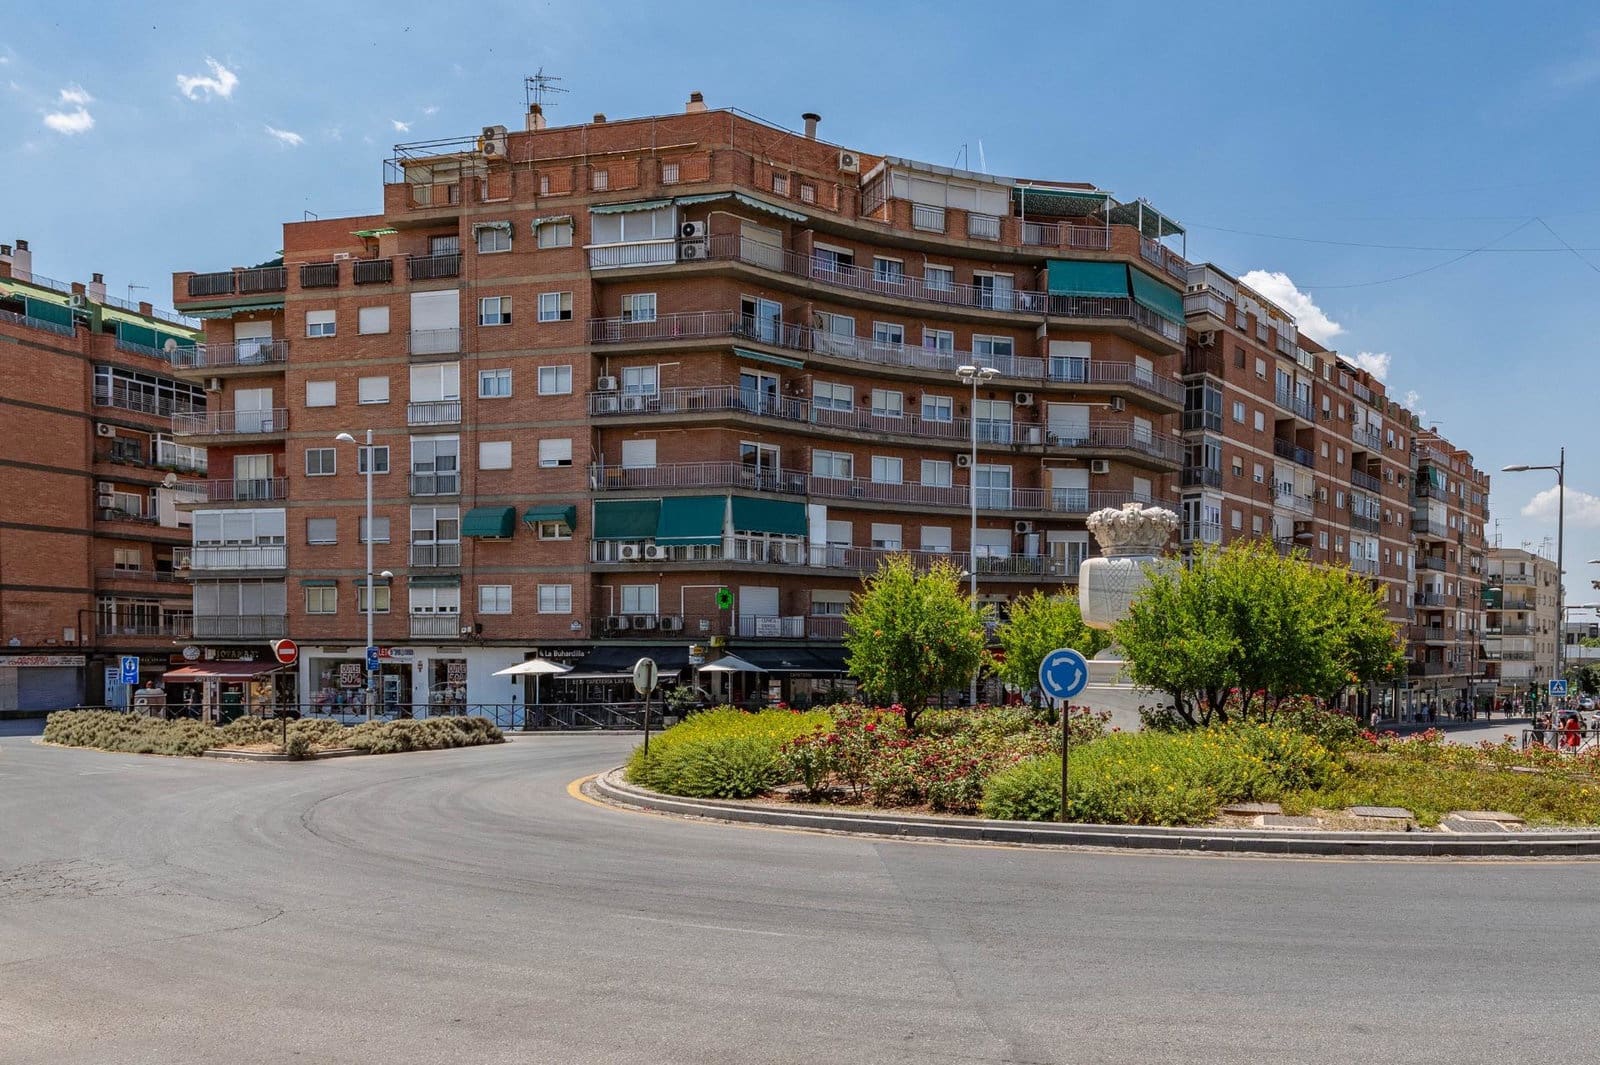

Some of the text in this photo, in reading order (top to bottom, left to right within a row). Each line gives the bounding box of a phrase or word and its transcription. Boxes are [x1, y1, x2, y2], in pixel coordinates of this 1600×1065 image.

[553, 649, 585, 657] Buhardilla
[341, 665, 360, 673] OUTLET
[341, 673, 361, 684] 50%
